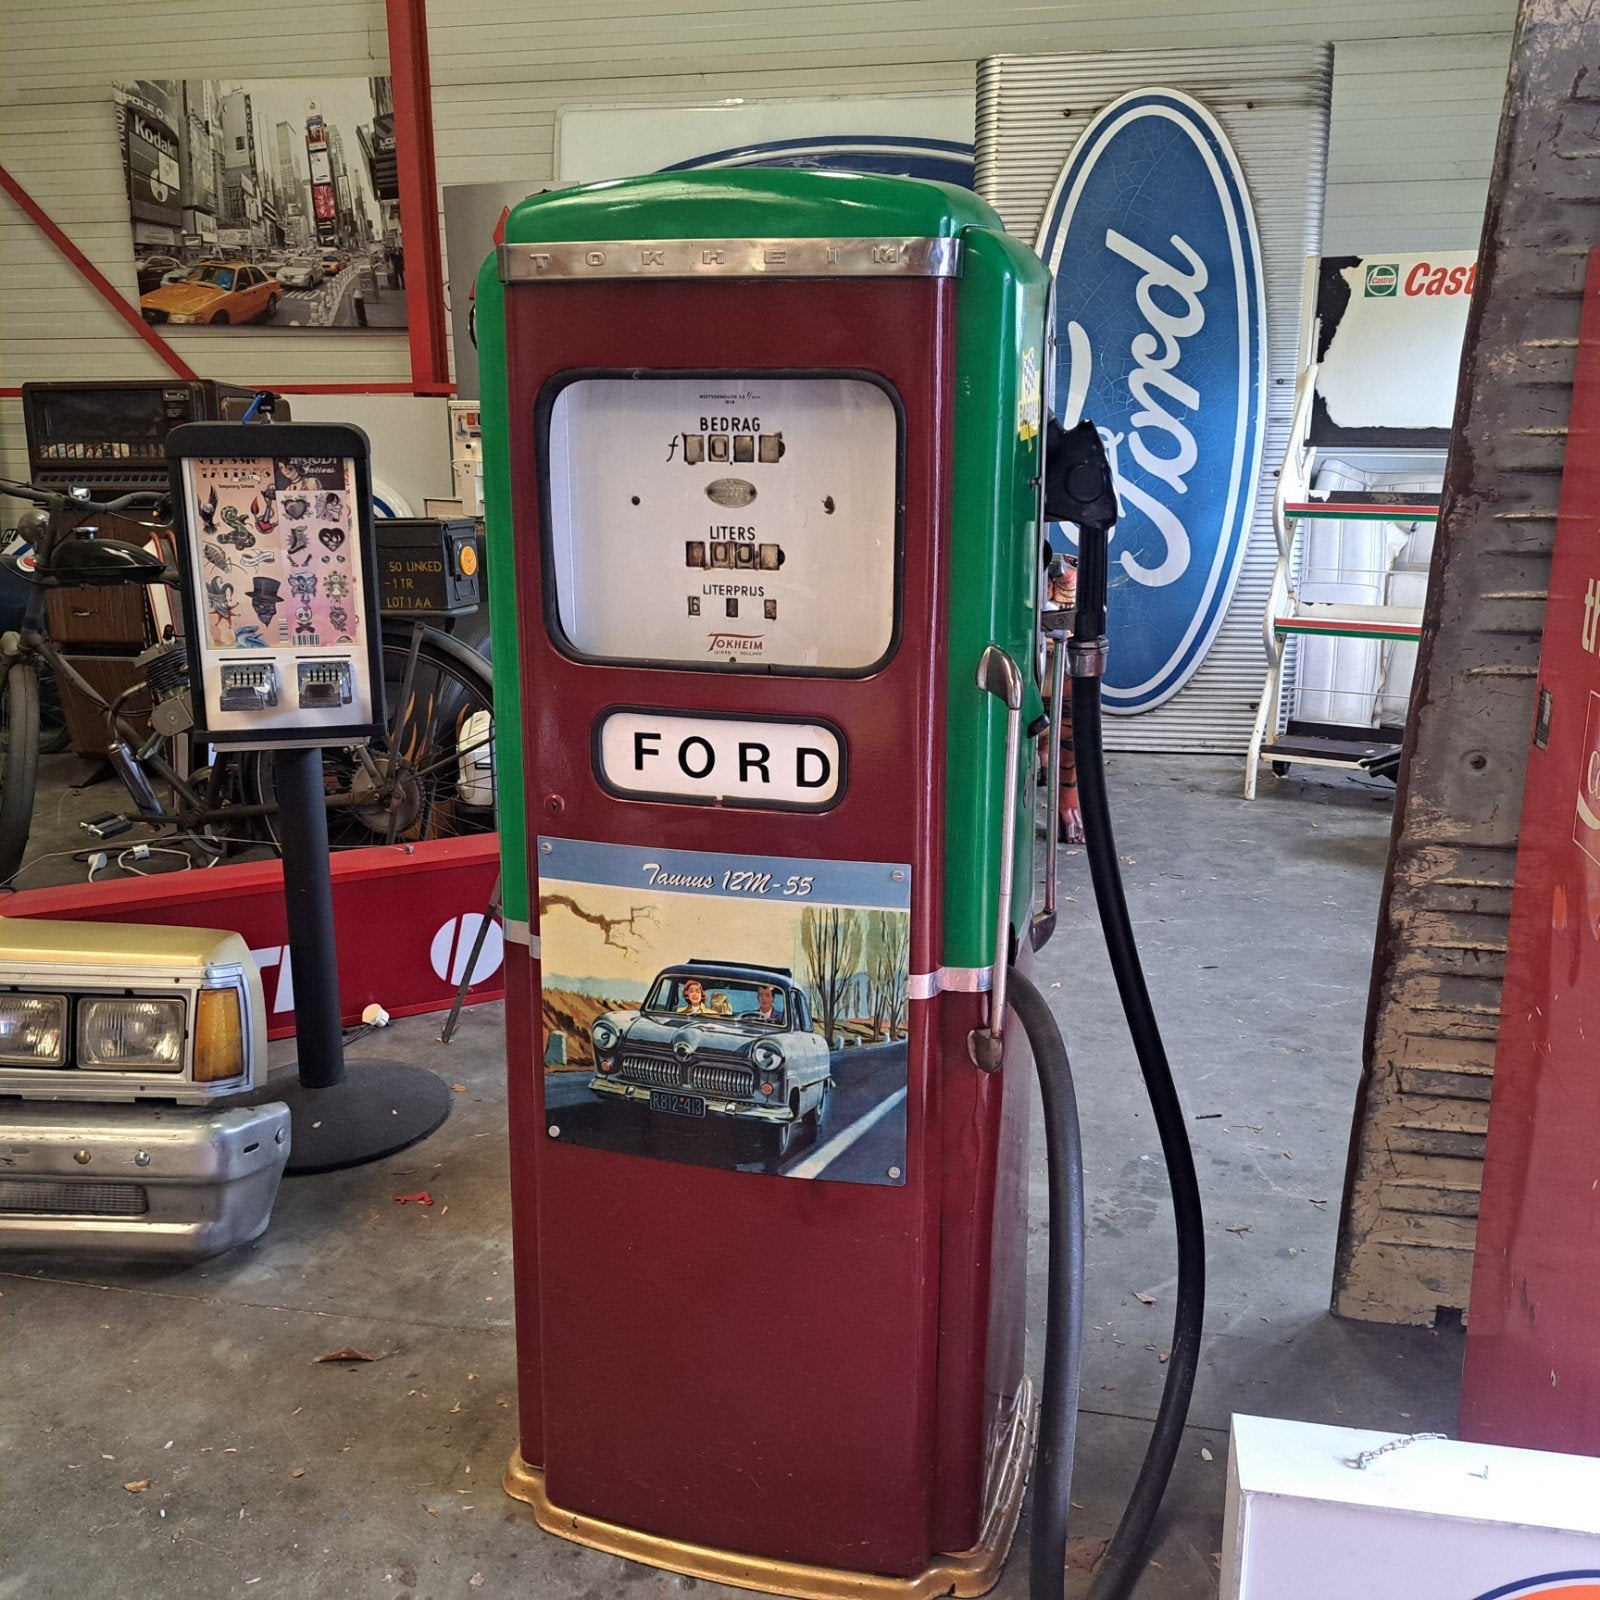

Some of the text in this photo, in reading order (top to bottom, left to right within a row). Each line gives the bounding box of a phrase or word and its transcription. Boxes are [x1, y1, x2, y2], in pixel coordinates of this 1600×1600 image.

[135, 113, 174, 157] Kodak
[530, 247, 901, 269] TOKHEIM
[1372, 276, 1395, 285] Castrol
[700, 417, 761, 432] BEDRAG
[710, 525, 756, 541] LITERS
[406, 561, 443, 572] LINKED
[703, 584, 764, 597] LITERPRIJS
[387, 597, 404, 608] LOT
[633, 732, 832, 789] FORD
[642, 863, 715, 889] Taunus
